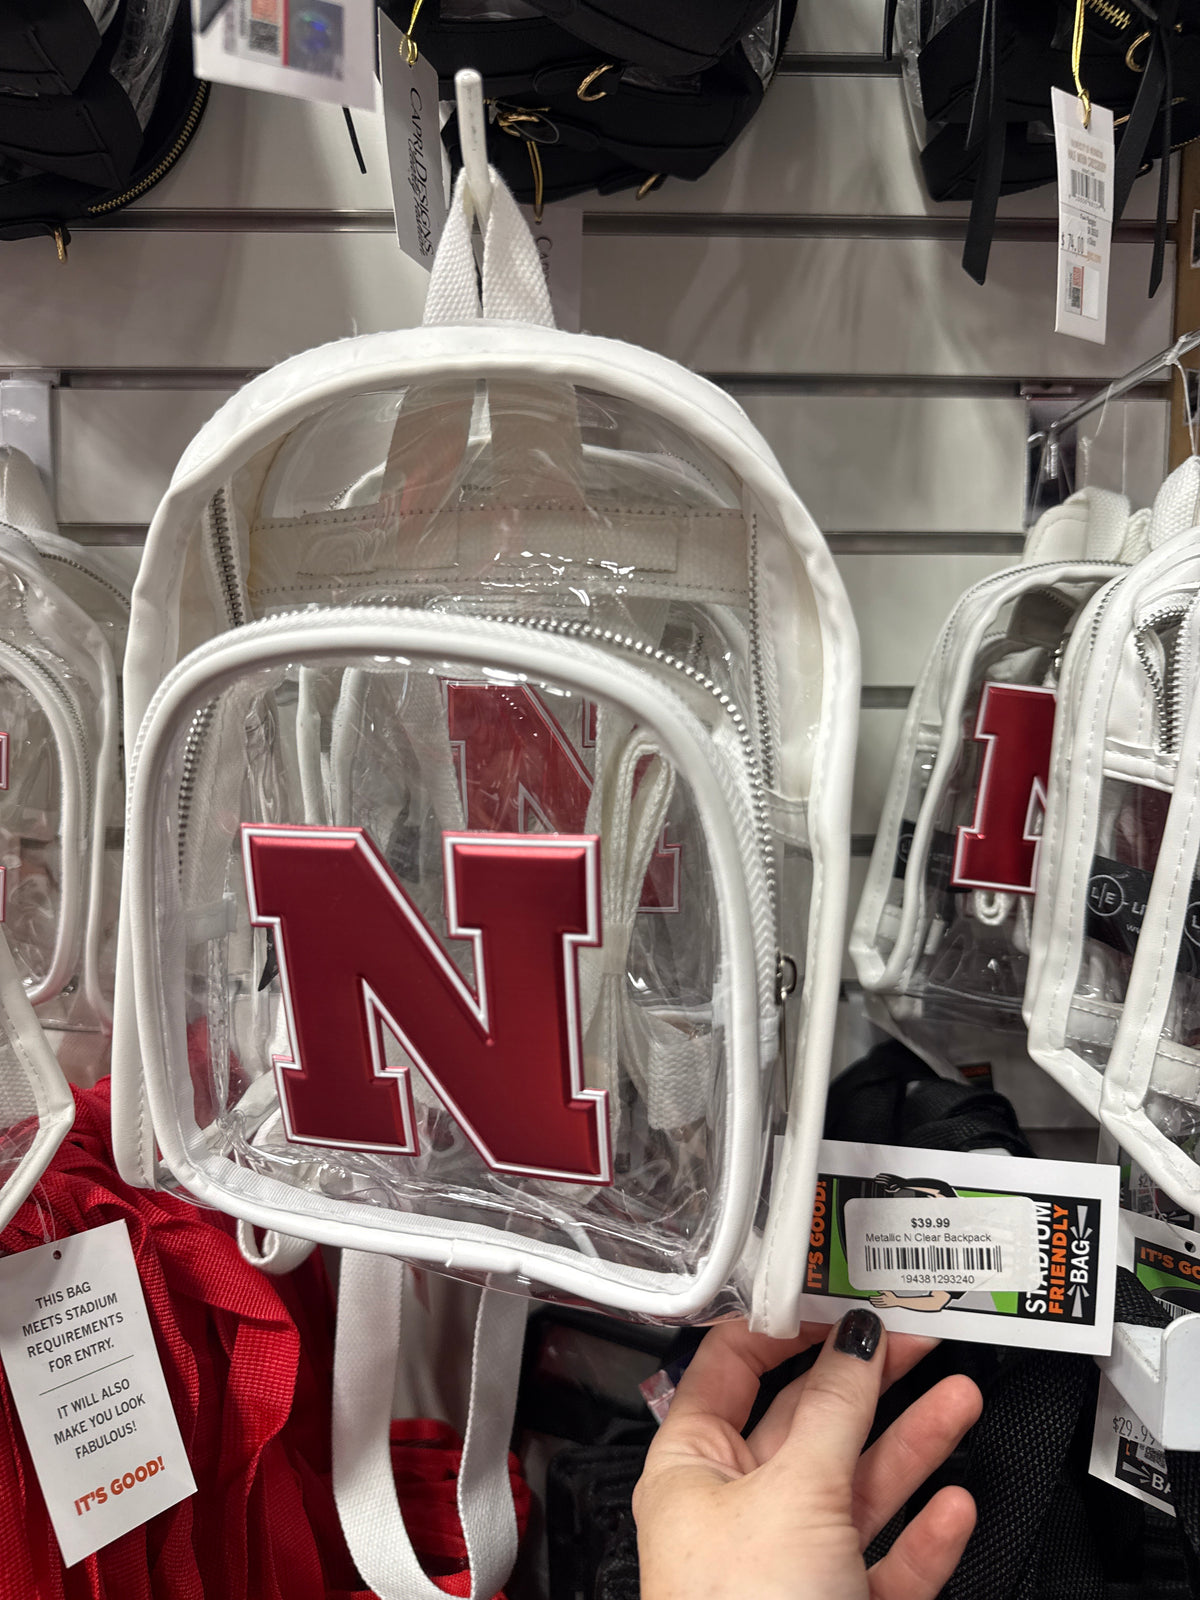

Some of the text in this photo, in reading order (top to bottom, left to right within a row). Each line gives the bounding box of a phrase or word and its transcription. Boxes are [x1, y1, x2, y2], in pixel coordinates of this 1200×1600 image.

[410, 88, 434, 255] CAPRI DESIGNS
[241, 823, 613, 1186] N
[807, 1181, 827, 1288] IT'S GOOD!
[865, 1233, 992, 1244] Metallic N Clear Backpack
[910, 1217, 951, 1229] $39.99
[1048, 1204, 1069, 1314] FRIENDLY
[1070, 1240, 1090, 1283] BAG
[1140, 1246, 1174, 1269] IT'S
[35, 1281, 91, 1309] THIS BAG
[900, 1275, 975, 1285] 194381293240
[22, 1292, 118, 1337] MEETS STADIUM
[27, 1312, 124, 1358] REQUIREMENTS
[48, 1337, 114, 1373] FOR ENTRY.
[53, 1393, 146, 1445] MAKE YOU LOOK
[57, 1378, 130, 1419] IT WILL ALSO
[75, 1420, 137, 1459] FABULOUS!
[74, 1455, 165, 1516] IT'S GOOD!
